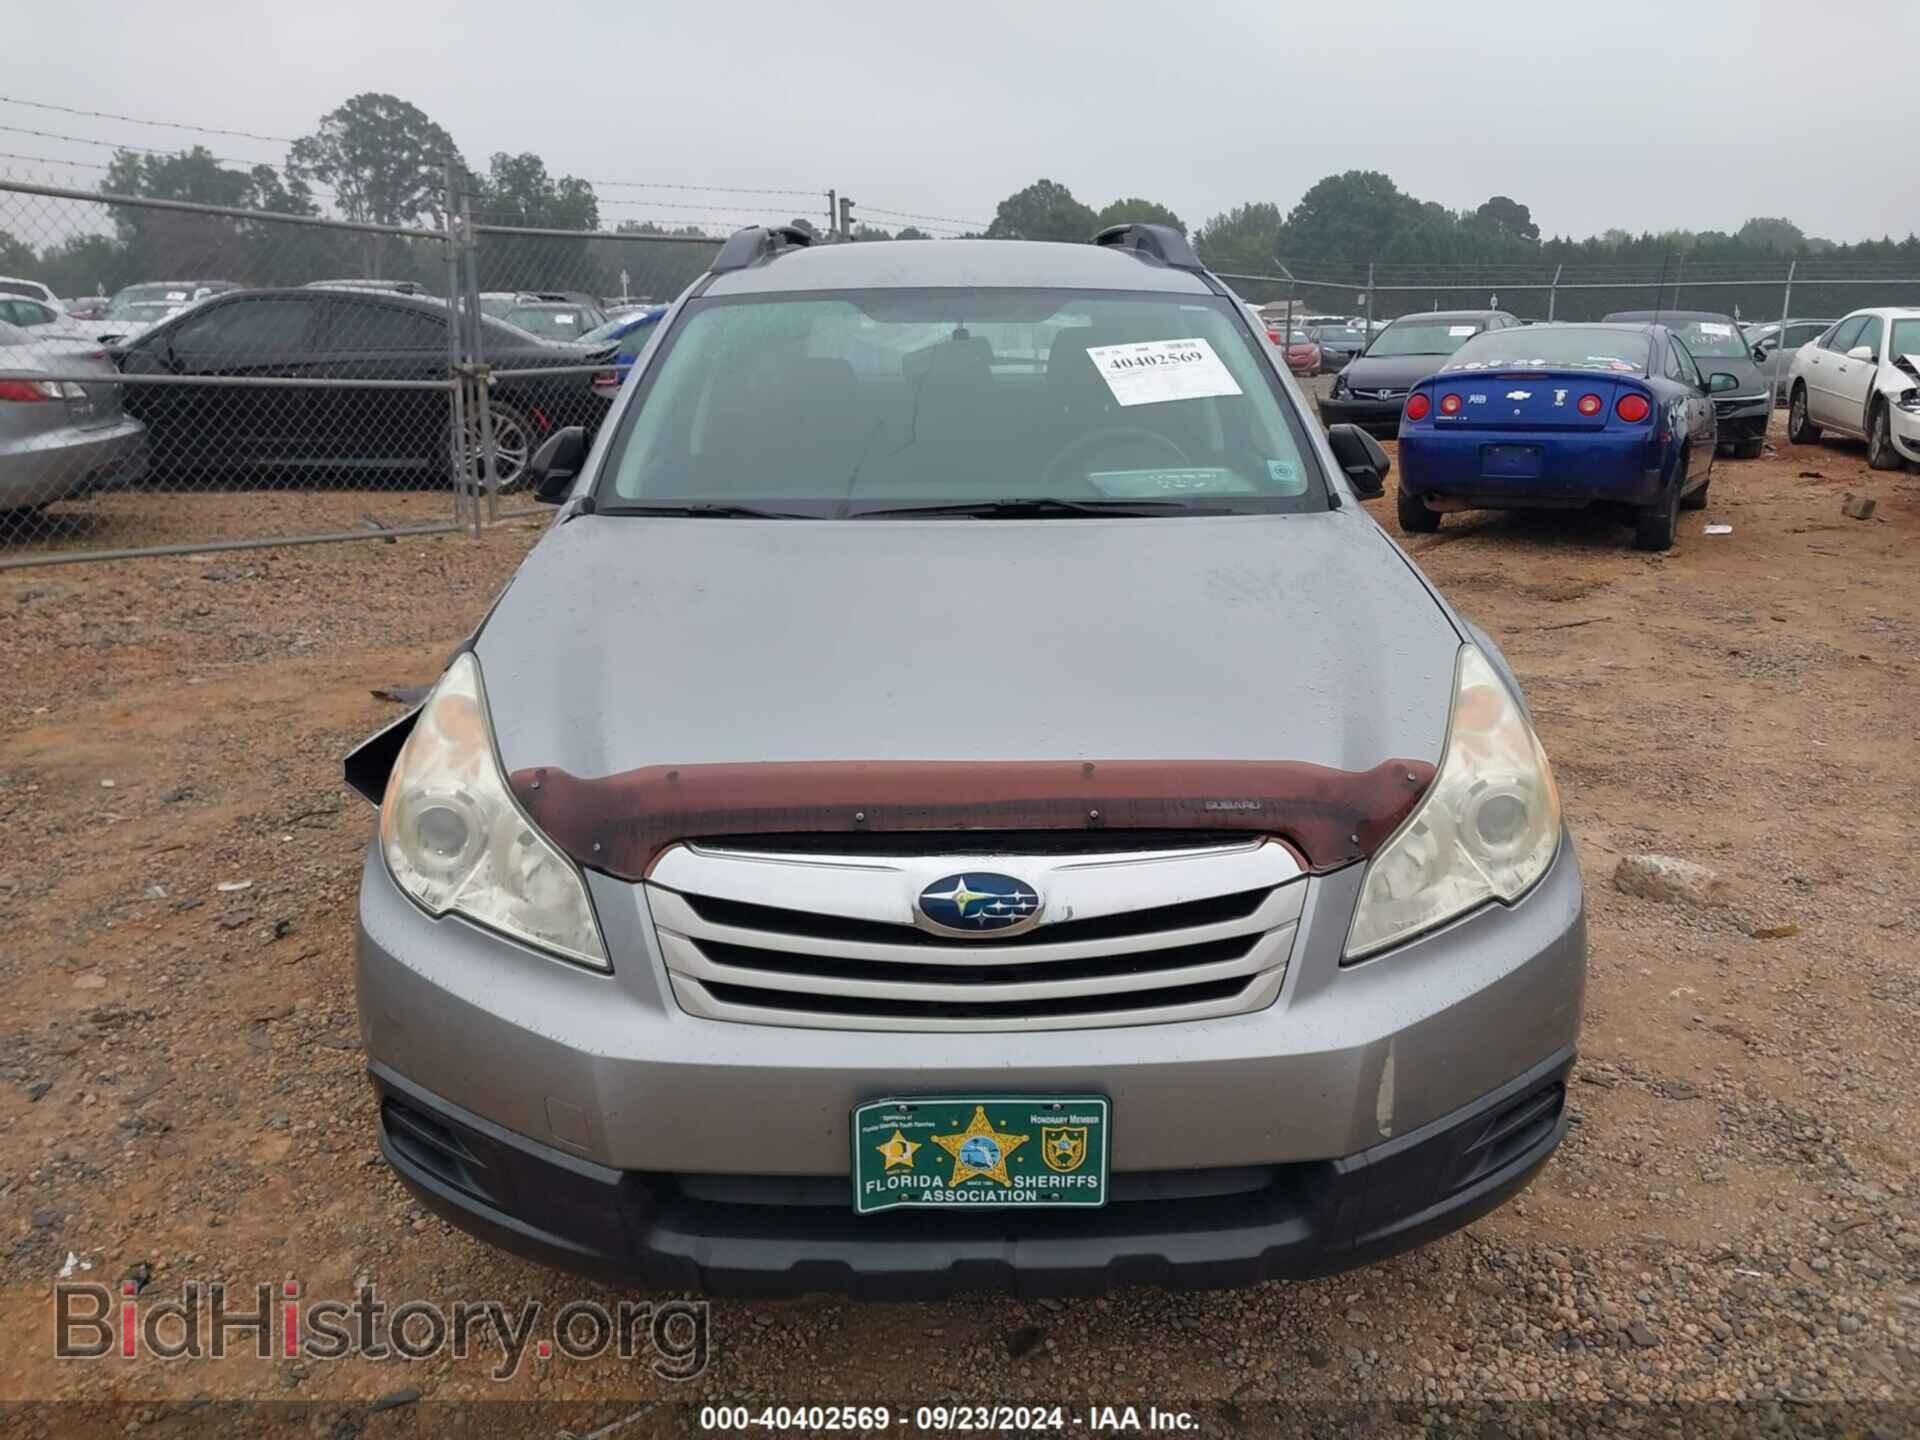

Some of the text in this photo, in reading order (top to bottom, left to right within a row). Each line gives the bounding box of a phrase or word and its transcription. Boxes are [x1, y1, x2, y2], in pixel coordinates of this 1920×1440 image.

[1110, 351, 1203, 369] 40402569
[1205, 800, 1261, 810] SUBARU
[1069, 1114, 1099, 1124] MEMBER
[865, 1175, 1098, 1195] FLORIDA SHERIFFS
[921, 1190, 1037, 1201] ASSOCIATION
